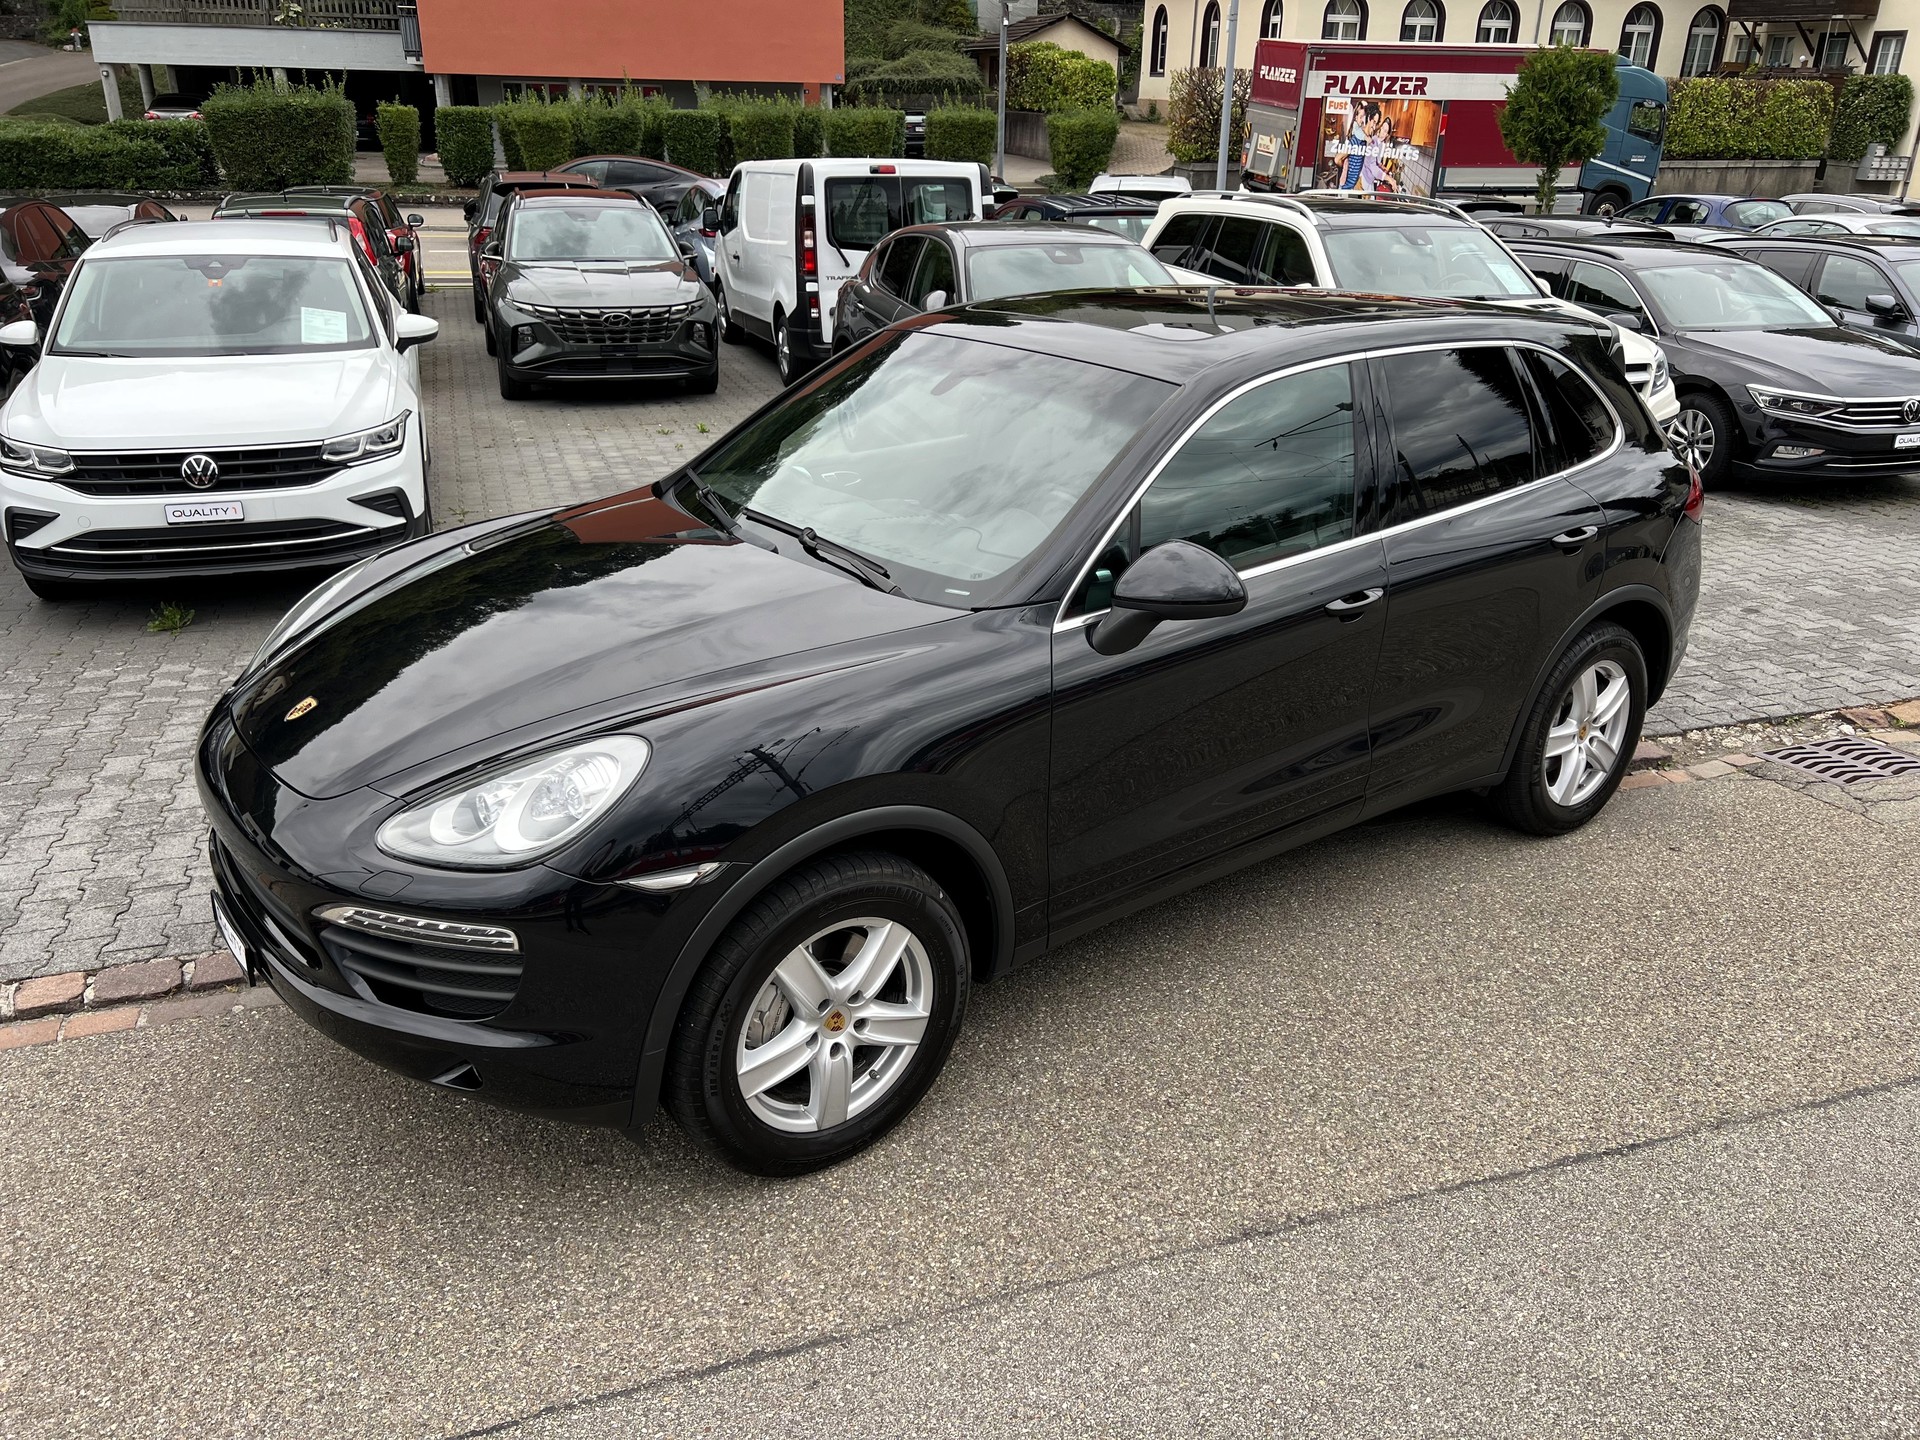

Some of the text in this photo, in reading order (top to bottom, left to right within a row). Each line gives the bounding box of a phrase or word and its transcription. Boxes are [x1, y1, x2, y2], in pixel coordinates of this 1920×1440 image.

[1260, 65, 1296, 83] PLANZER
[1324, 75, 1428, 95] PLANZER
[1328, 100, 1348, 110] Fust
[1331, 139, 1419, 160] Zuhause läufts
[172, 507, 229, 518] QUALITY
